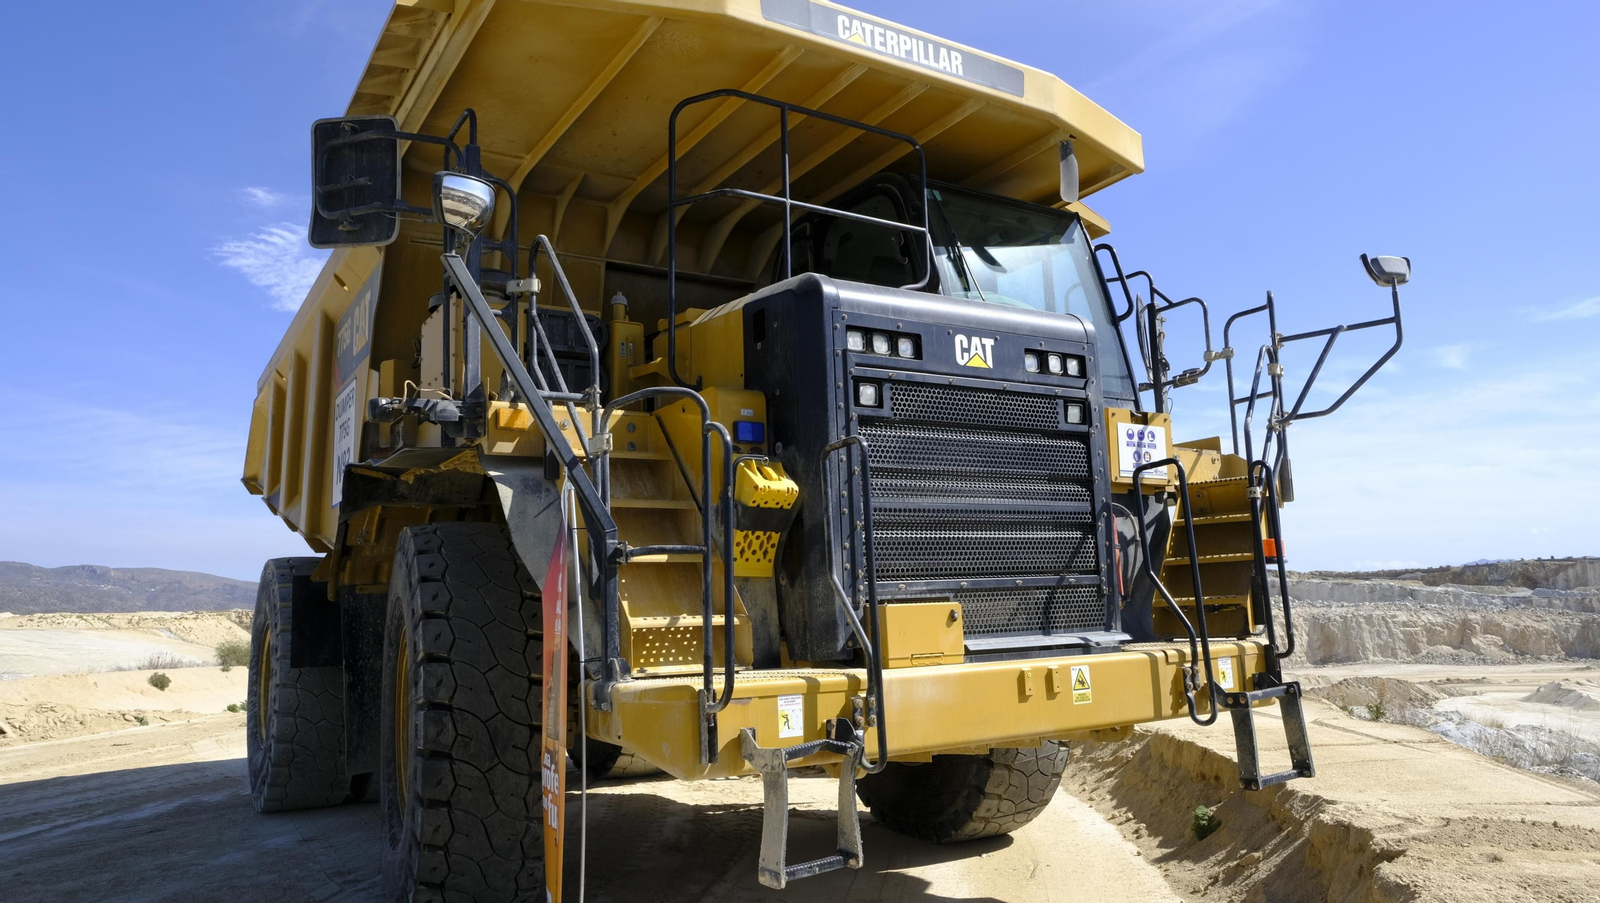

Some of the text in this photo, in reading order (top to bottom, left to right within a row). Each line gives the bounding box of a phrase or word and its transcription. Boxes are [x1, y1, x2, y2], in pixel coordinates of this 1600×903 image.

[837, 14, 963, 76] CATERPILLAR
[353, 289, 371, 357] CAT
[954, 333, 995, 369] CAT
[335, 387, 355, 422] DUMPER
